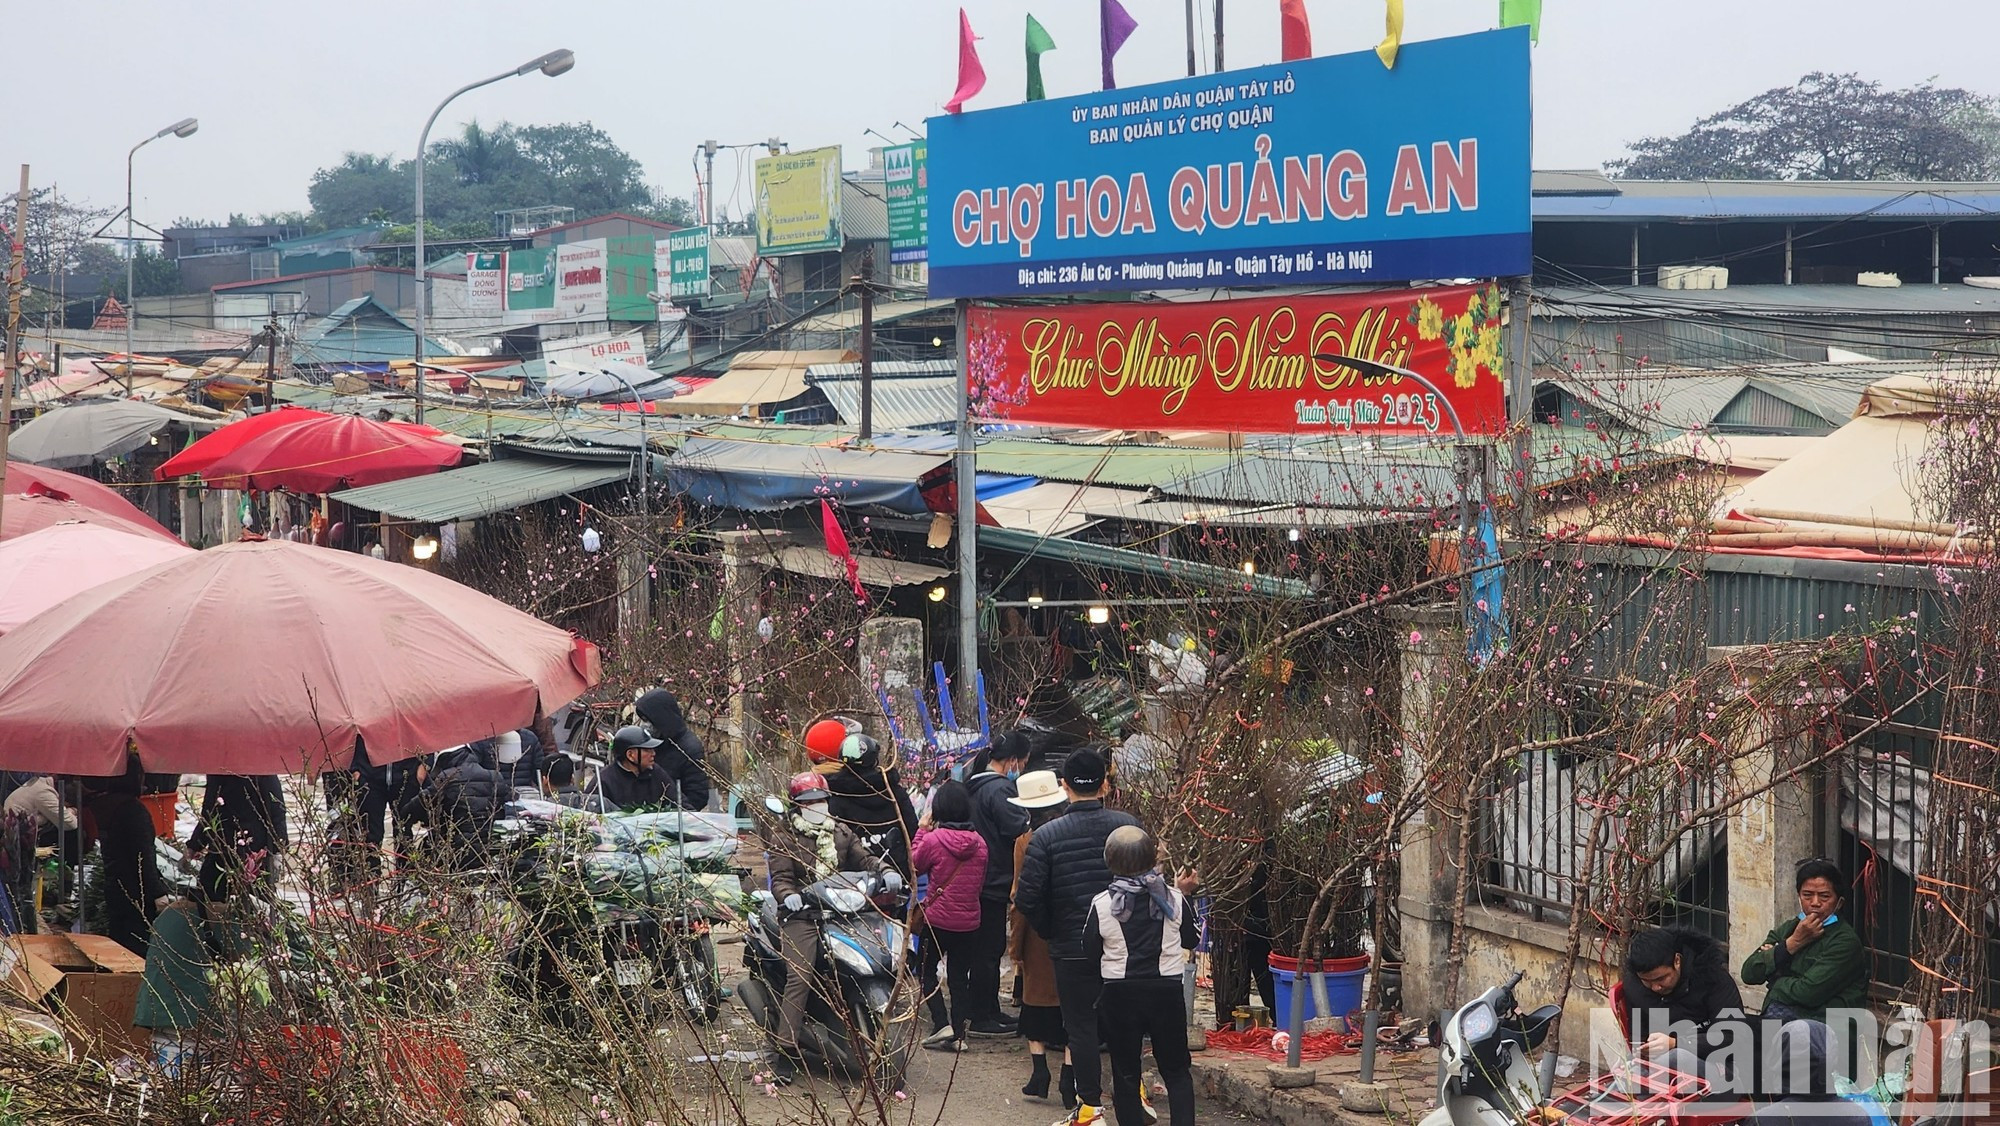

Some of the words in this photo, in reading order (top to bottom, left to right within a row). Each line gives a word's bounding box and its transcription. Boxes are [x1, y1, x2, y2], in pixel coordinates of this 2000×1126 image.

[1072, 106, 1088, 123] ỦY
[1091, 103, 1118, 120] BAN
[1122, 97, 1158, 116] NHÂN
[1163, 92, 1191, 110] DÂN
[1196, 87, 1235, 107] QUẬN
[1239, 79, 1268, 99] TÂY
[1273, 71, 1295, 95] HỒ
[1089, 128, 1119, 145] BAN
[1123, 118, 1163, 143] QUẢN
[1168, 114, 1186, 135] LÝ
[1190, 111, 1223, 133] CHỢ
[1227, 104, 1273, 129] QUẬN
[952, 183, 1044, 257] CHỢ
[1055, 173, 1156, 240] HOA
[1168, 134, 1368, 235] QUẢNG
[1386, 138, 1478, 217] AN
[1018, 268, 1035, 288] Địa
[1037, 265, 1056, 284] chỉ:
[1059, 267, 1079, 283] 236
[1080, 262, 1094, 282] Âu
[1097, 264, 1112, 281] Cơ
[1121, 262, 1164, 281] Phường
[1167, 258, 1203, 280] Quảng
[1206, 258, 1223, 276] An
[1234, 255, 1267, 277] Quận
[1270, 254, 1292, 275] Tây
[1296, 251, 1314, 272] Hồ
[1326, 251, 1345, 271] Hà
[1348, 250, 1373, 273] Nội
[591, 345, 605, 358] LỌ
[608, 341, 631, 353] HOA
[1021, 317, 1096, 396] Chúc
[1096, 316, 1205, 416] Mừng
[1207, 306, 1310, 393] Năm
[1309, 307, 1415, 392] Mới
[1295, 398, 1327, 424] Xuân
[1327, 398, 1352, 431] Quý
[1353, 398, 1382, 424] Mão
[1382, 393, 1440, 431] 2023
